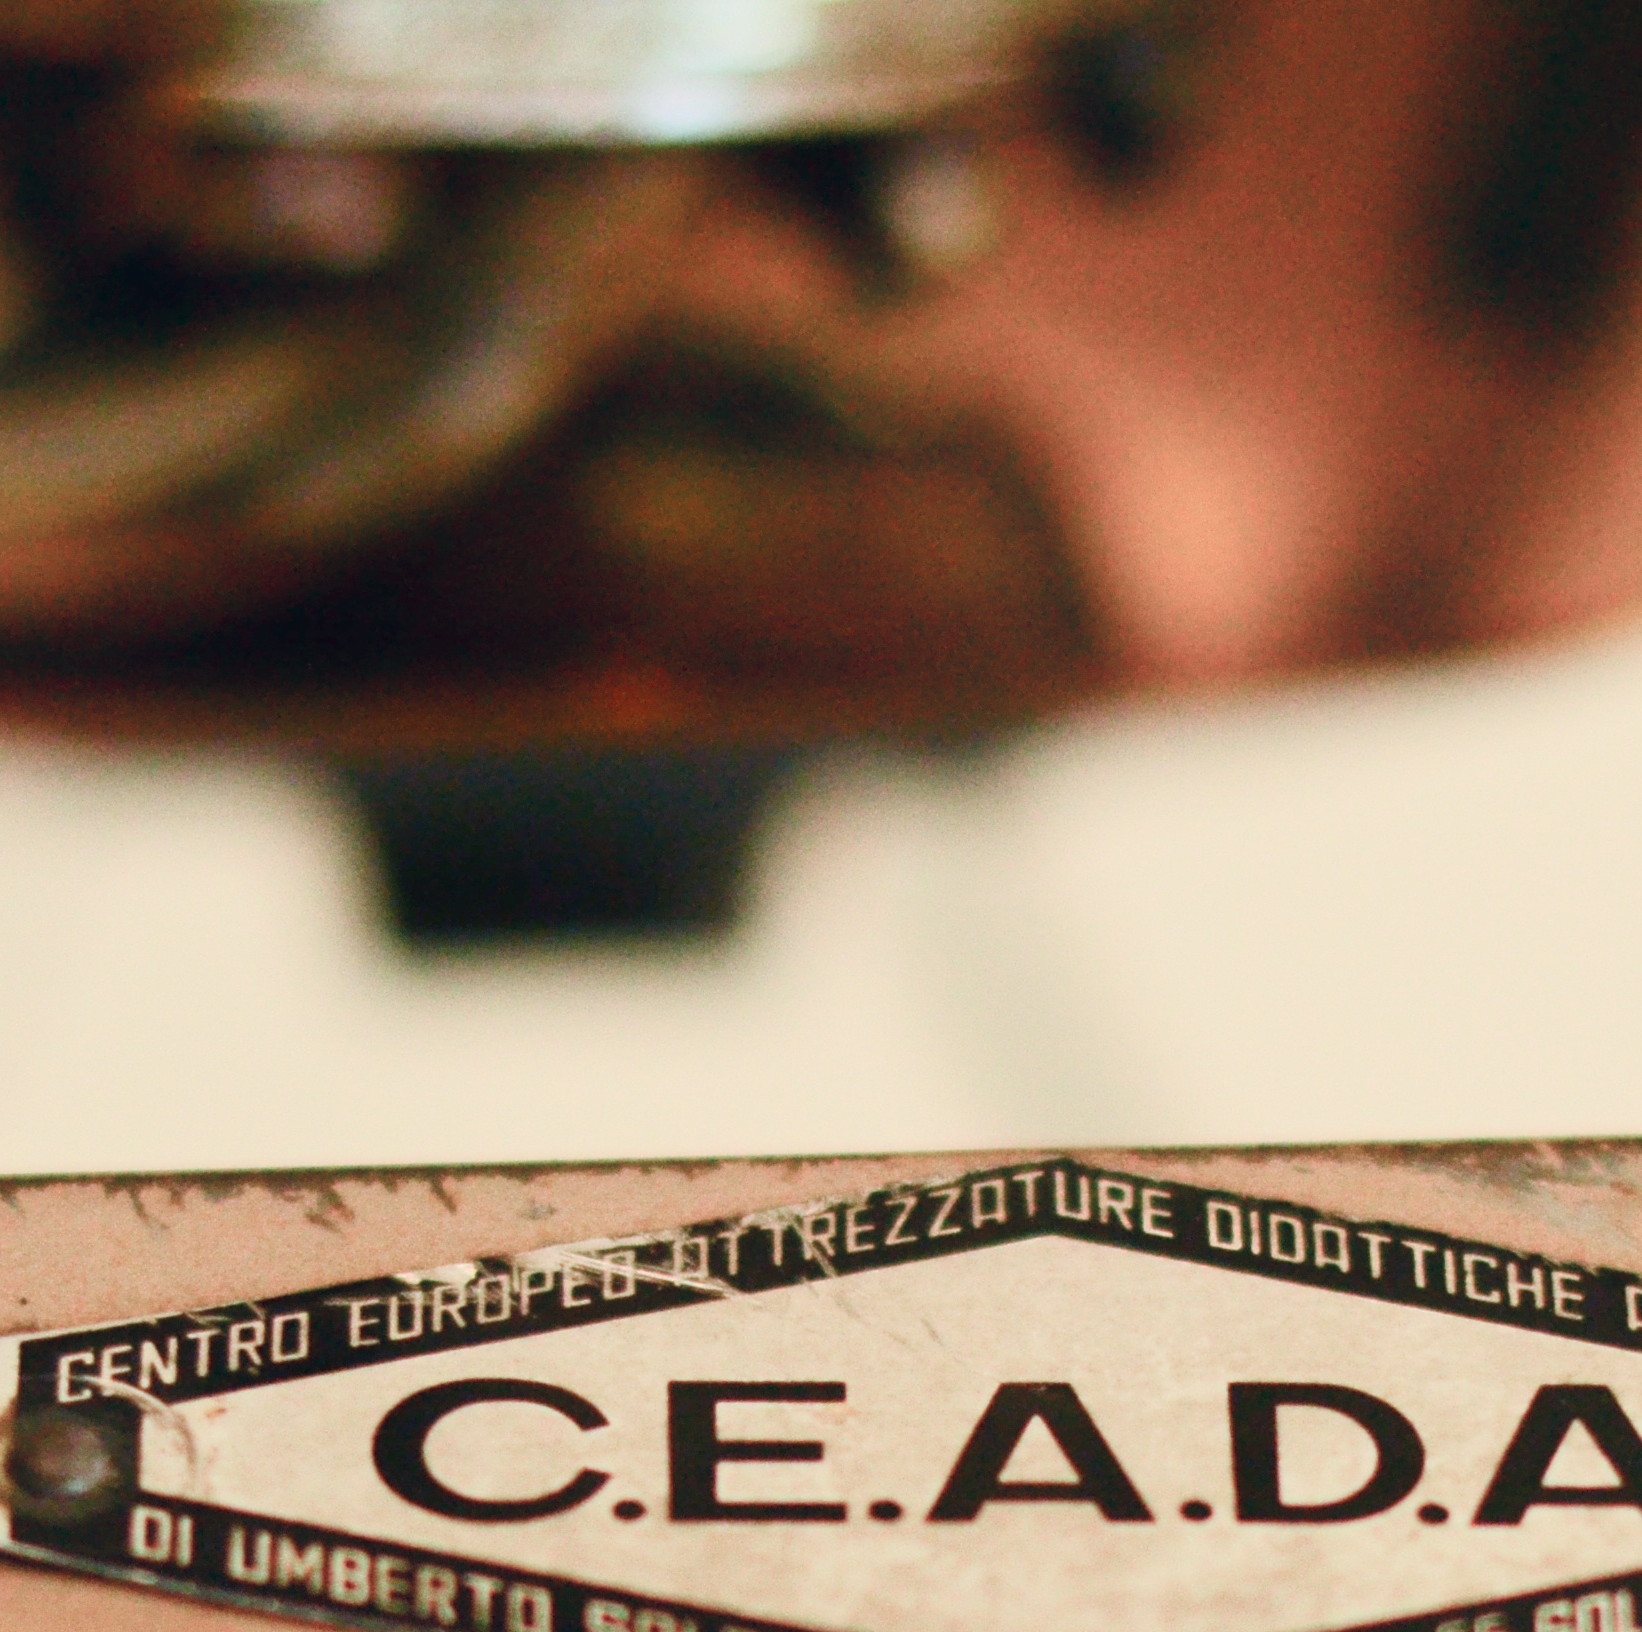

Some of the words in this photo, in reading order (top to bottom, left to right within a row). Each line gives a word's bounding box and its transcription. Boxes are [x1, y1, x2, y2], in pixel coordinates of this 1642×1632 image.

[58, 1311, 309, 1403] CENTRO
[348, 1250, 637, 1347] EUROPEO
[671, 1169, 1175, 1287] ATTREZZATURE
[1206, 1199, 1585, 1322] DIDATTICHE
[128, 1504, 195, 1567] DI
